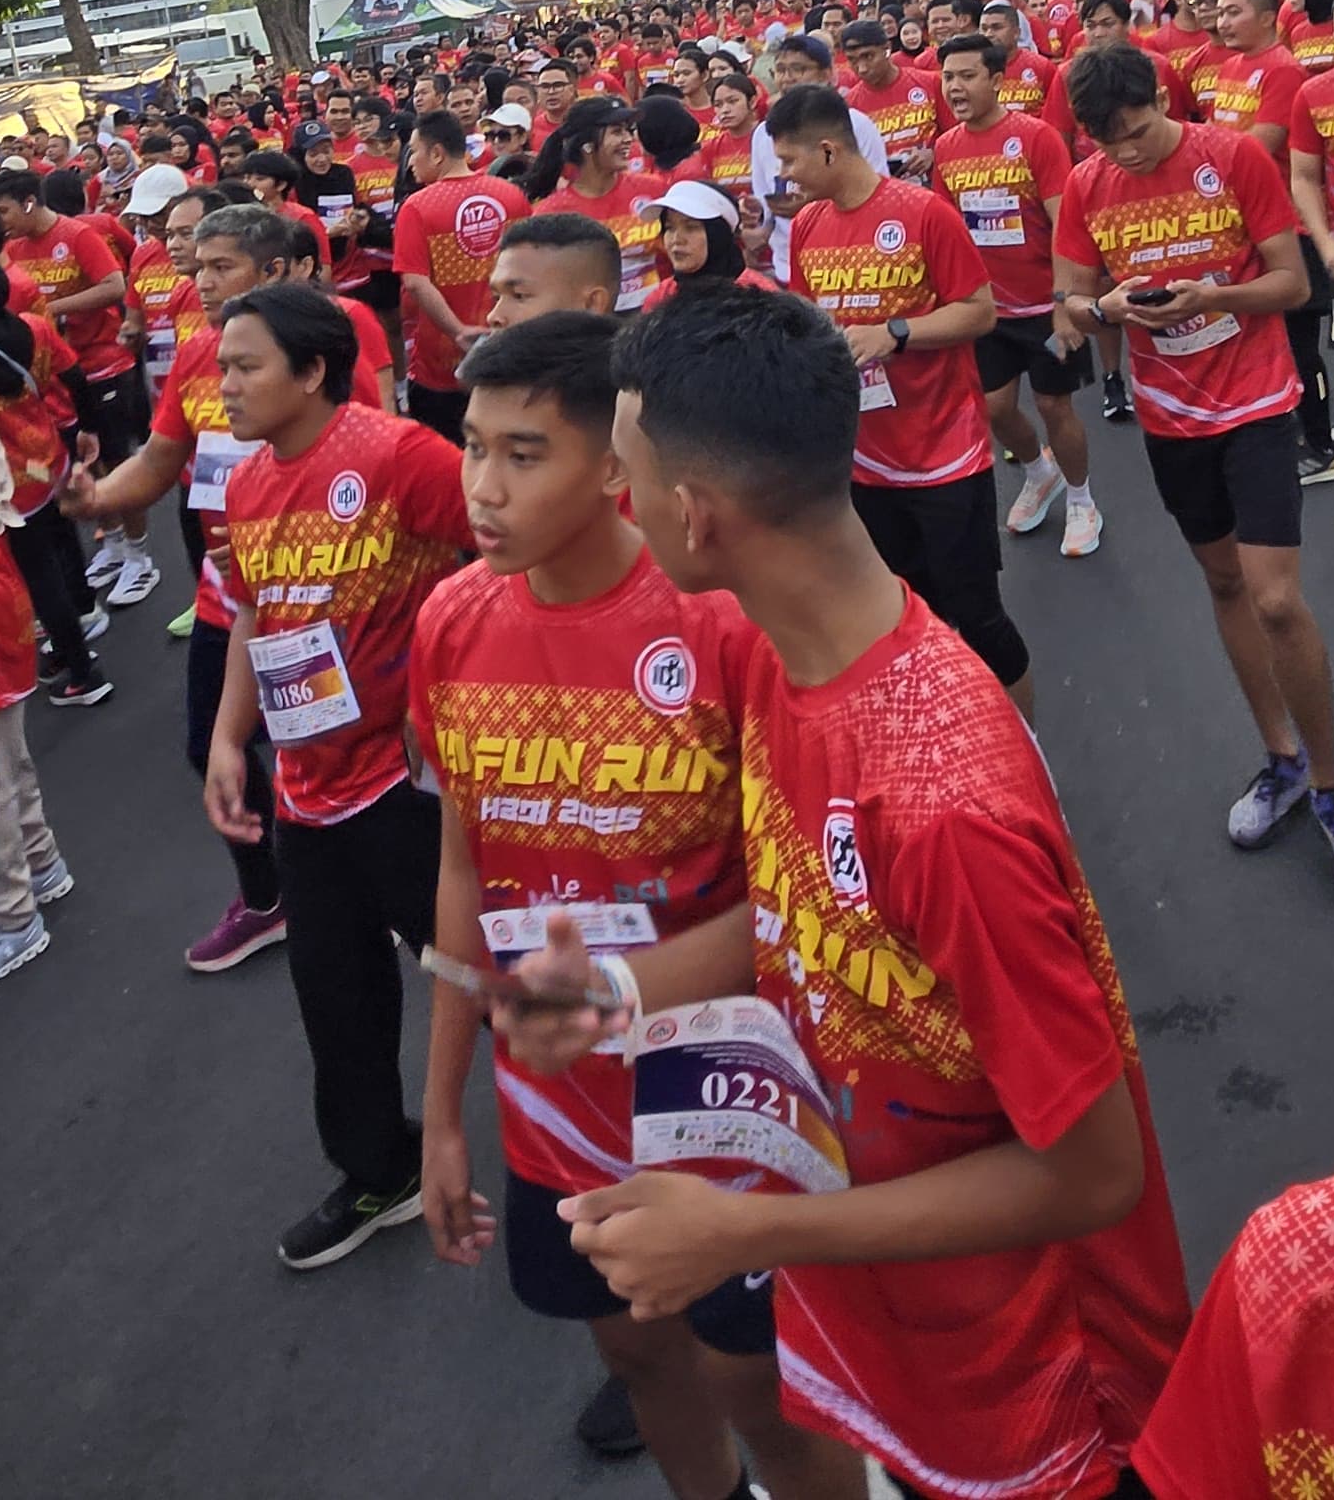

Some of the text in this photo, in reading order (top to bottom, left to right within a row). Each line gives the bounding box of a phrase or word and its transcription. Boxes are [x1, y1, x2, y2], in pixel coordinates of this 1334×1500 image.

[954, 167, 1035, 191] FUN RUN
[464, 204, 487, 224] 117
[1122, 216, 1180, 249] FUN
[1186, 206, 1244, 237] RUN
[810, 262, 926, 292] FUN RUN
[249, 531, 395, 583] FUN RUN
[272, 678, 315, 710] 0186
[474, 736, 586, 786] FUN
[594, 744, 729, 793] RUN
[557, 798, 644, 835] 2025
[551, 873, 581, 899] Le
[700, 1071, 799, 1131] 0221
